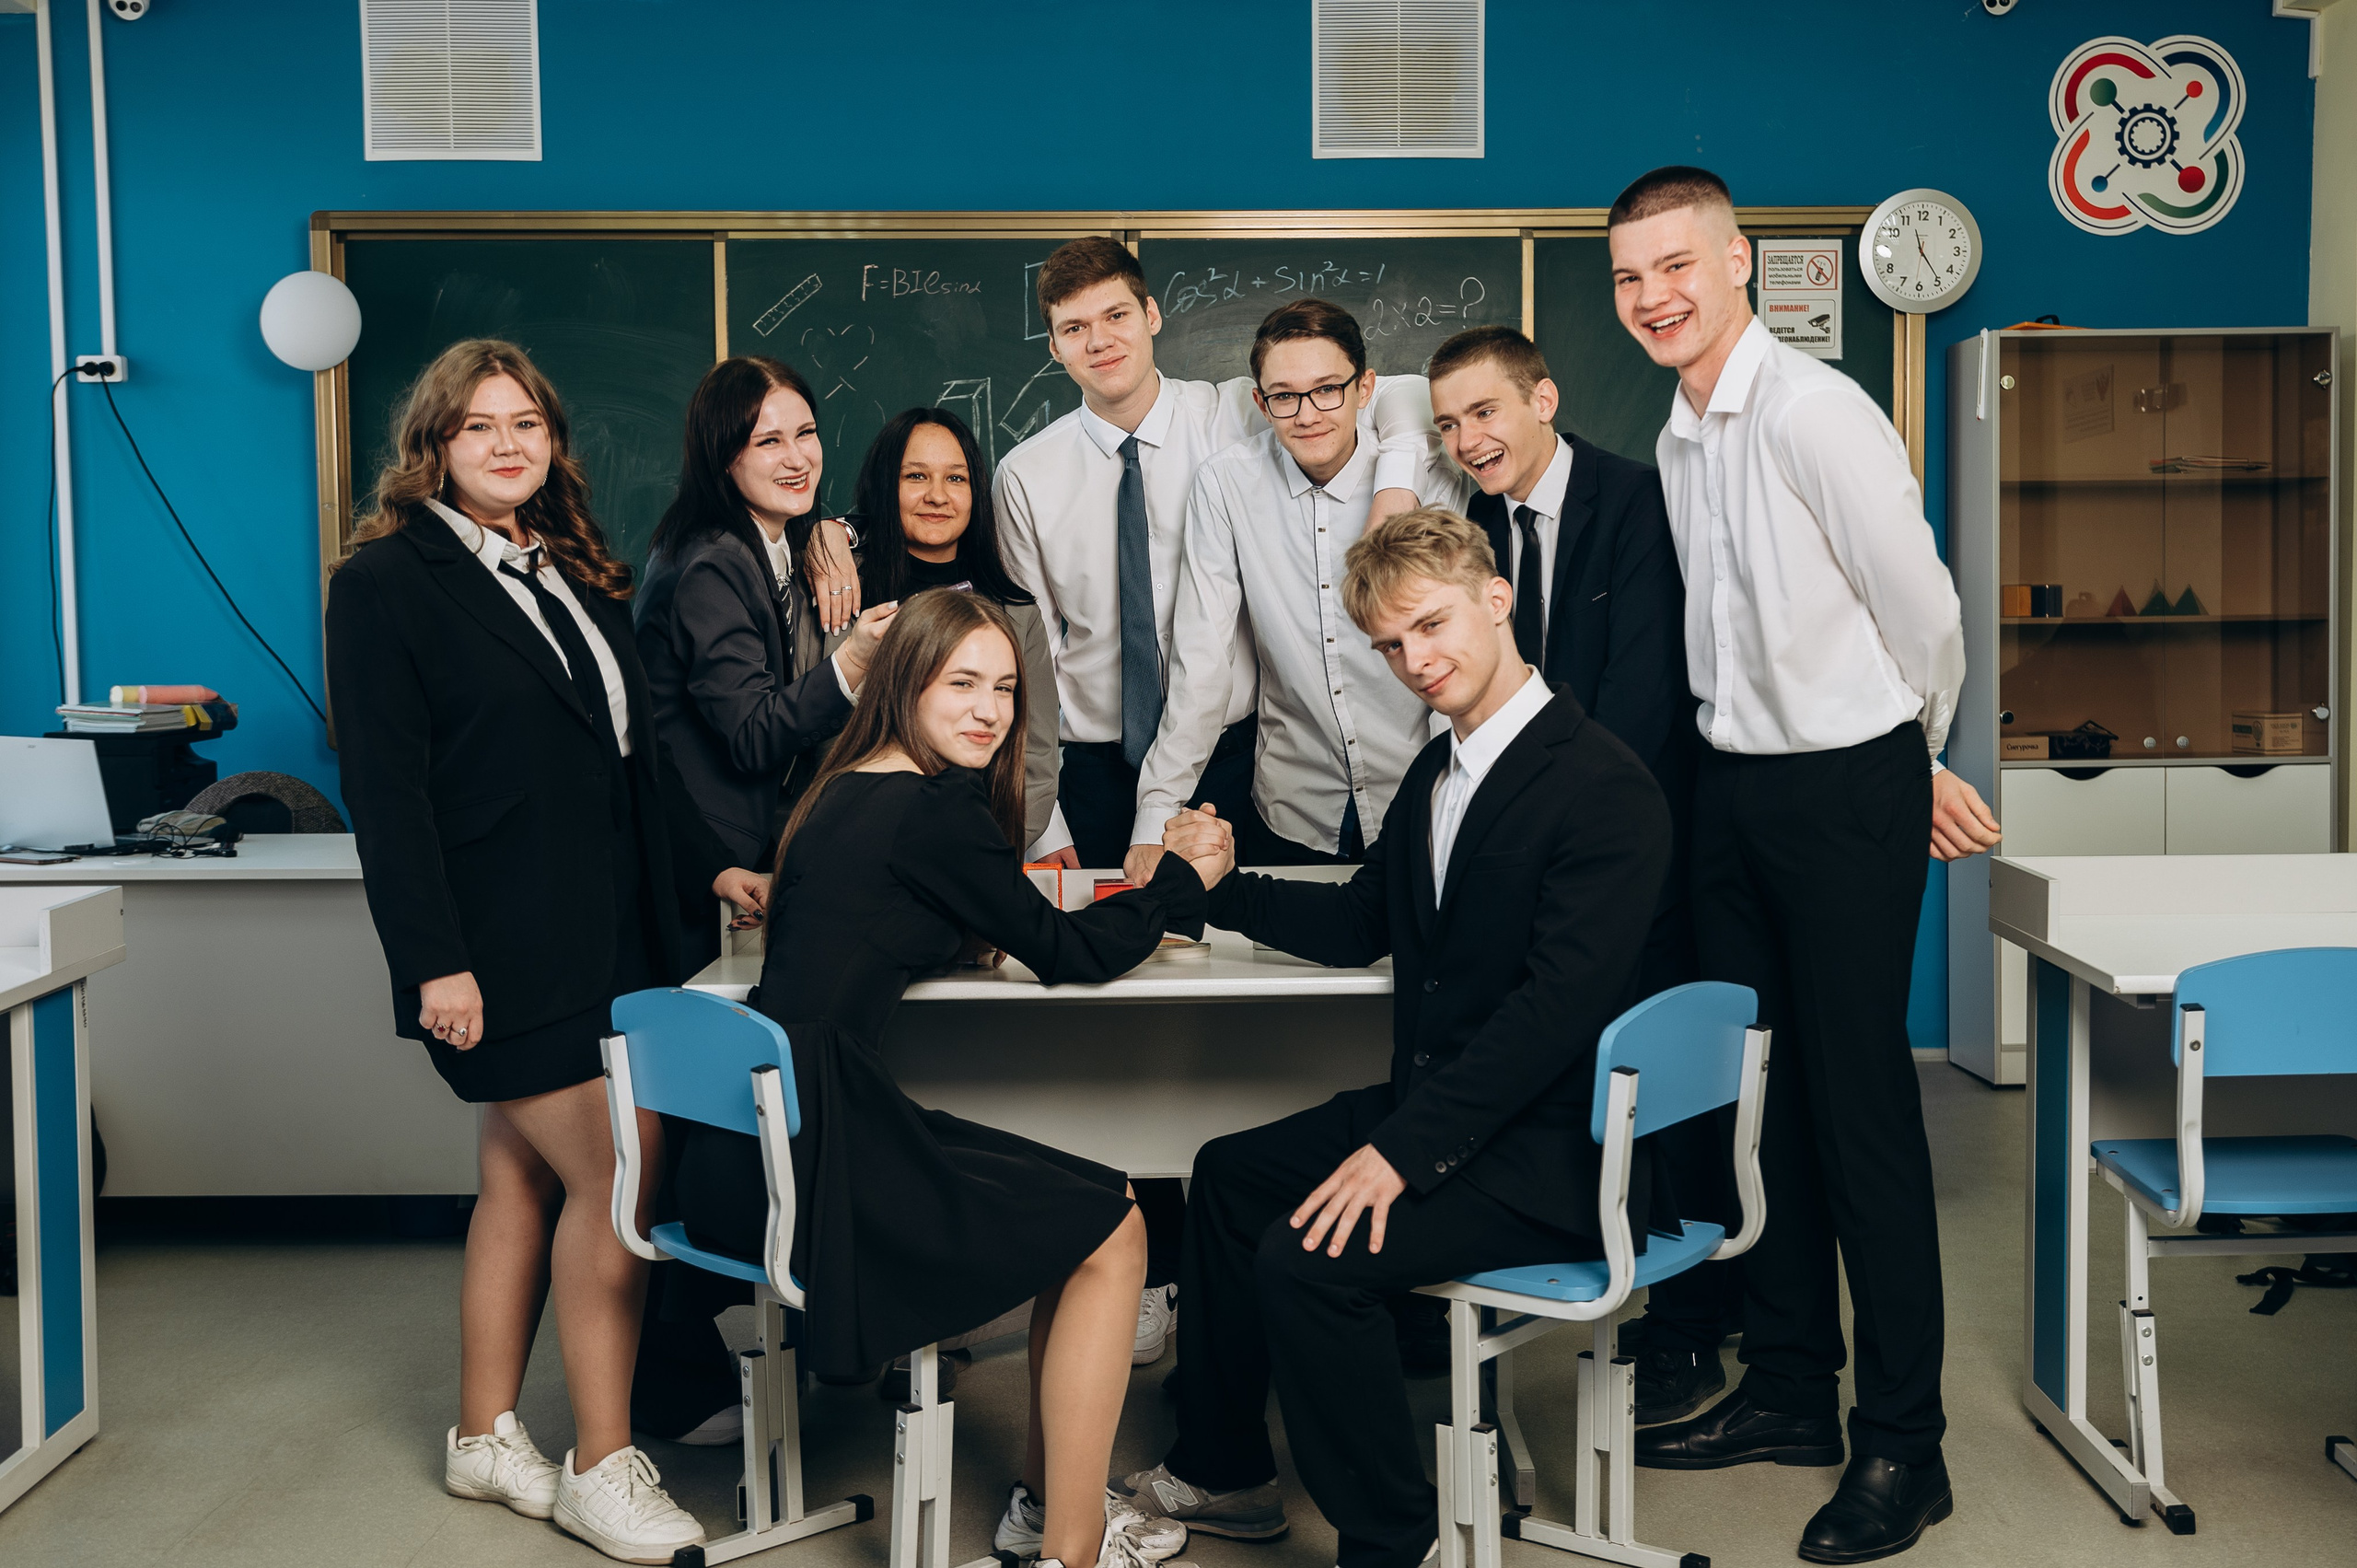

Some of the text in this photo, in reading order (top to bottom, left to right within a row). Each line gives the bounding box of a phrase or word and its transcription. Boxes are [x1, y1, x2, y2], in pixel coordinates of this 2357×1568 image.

[1901, 215, 1910, 226] 11
[1917, 211, 1929, 221] 12
[1938, 216, 1943, 226] 1
[1949, 228, 1956, 238] 2
[1953, 246, 1960, 256] 3
[1767, 255, 1805, 265] ЗАПРЕЩАЕТСЯ
[1887, 263, 1894, 273] 8
[1946, 264, 1954, 274] 4
[1900, 276, 1908, 286] 7
[1916, 281, 1923, 291] 6
[1933, 276, 1941, 286] 5
[1769, 304, 1810, 313] ВНИМАНИЕ!
[1773, 335, 1831, 343] ДЕОНАБЛЮДЕНИЕ!
[1152, 1476, 1200, 1513] N
